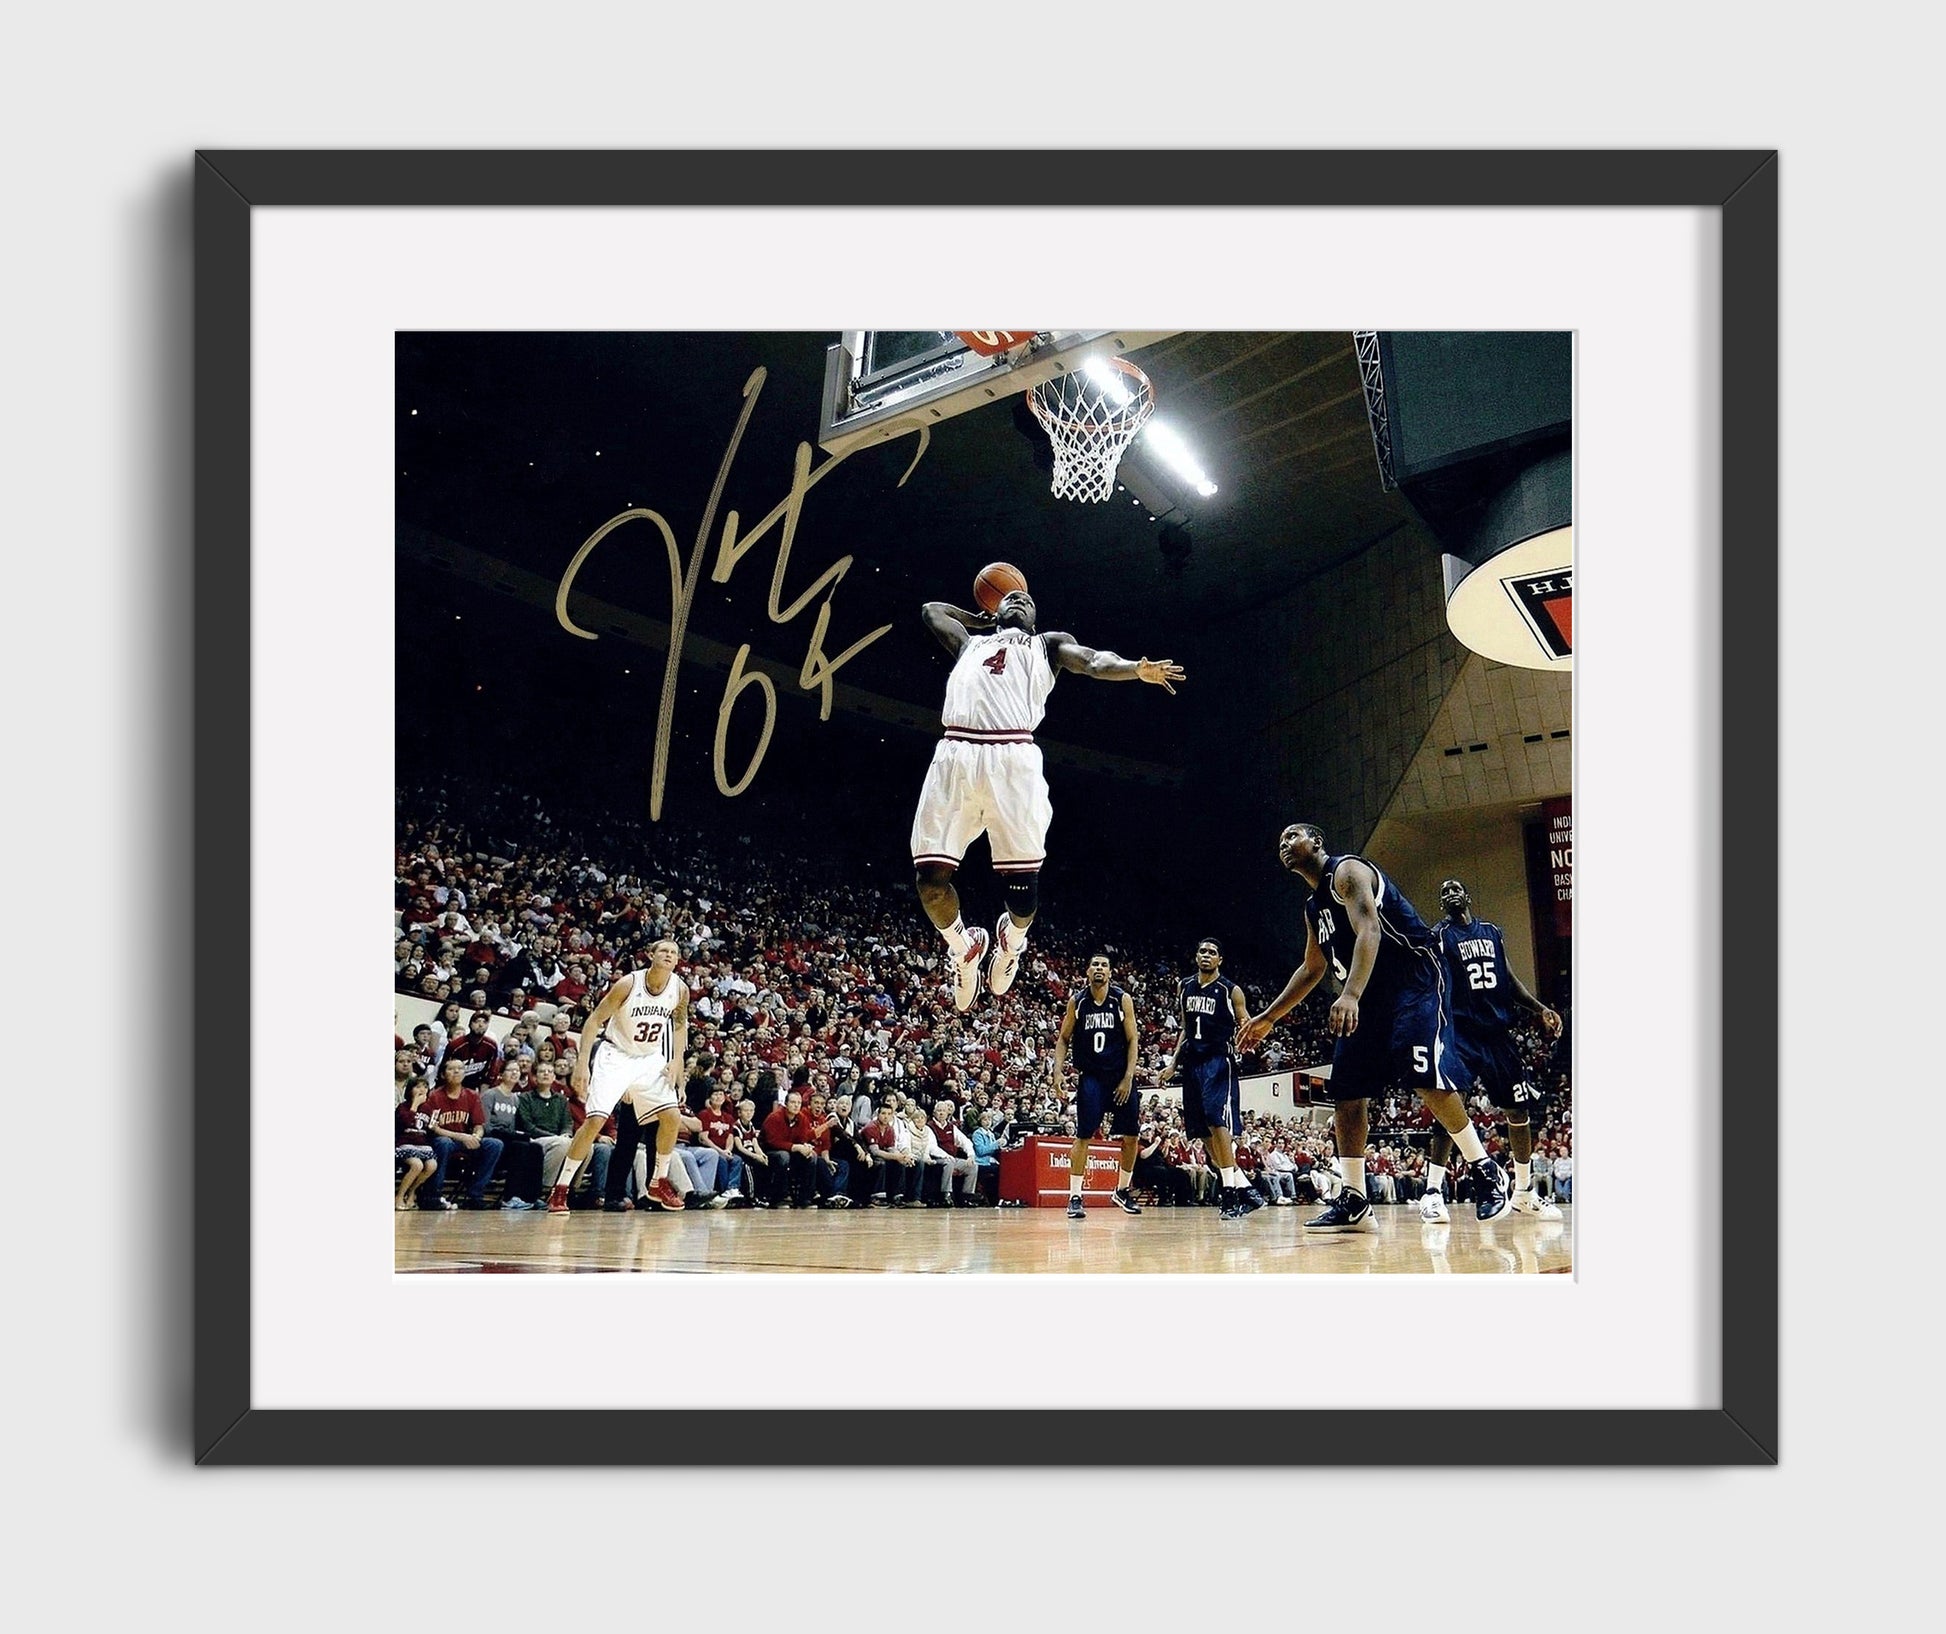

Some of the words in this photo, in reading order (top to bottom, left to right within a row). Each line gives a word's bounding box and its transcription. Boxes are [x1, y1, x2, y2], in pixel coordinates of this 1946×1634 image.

[982, 647, 1008, 676] 4
[1457, 939, 1496, 961] HOWARD
[1466, 961, 1498, 990] 25
[633, 1021, 664, 1043] 32
[1194, 1016, 1203, 1040] 1
[1093, 1031, 1106, 1053] 0
[1412, 1045, 1429, 1073] 5
[1049, 1152, 1072, 1168] India
